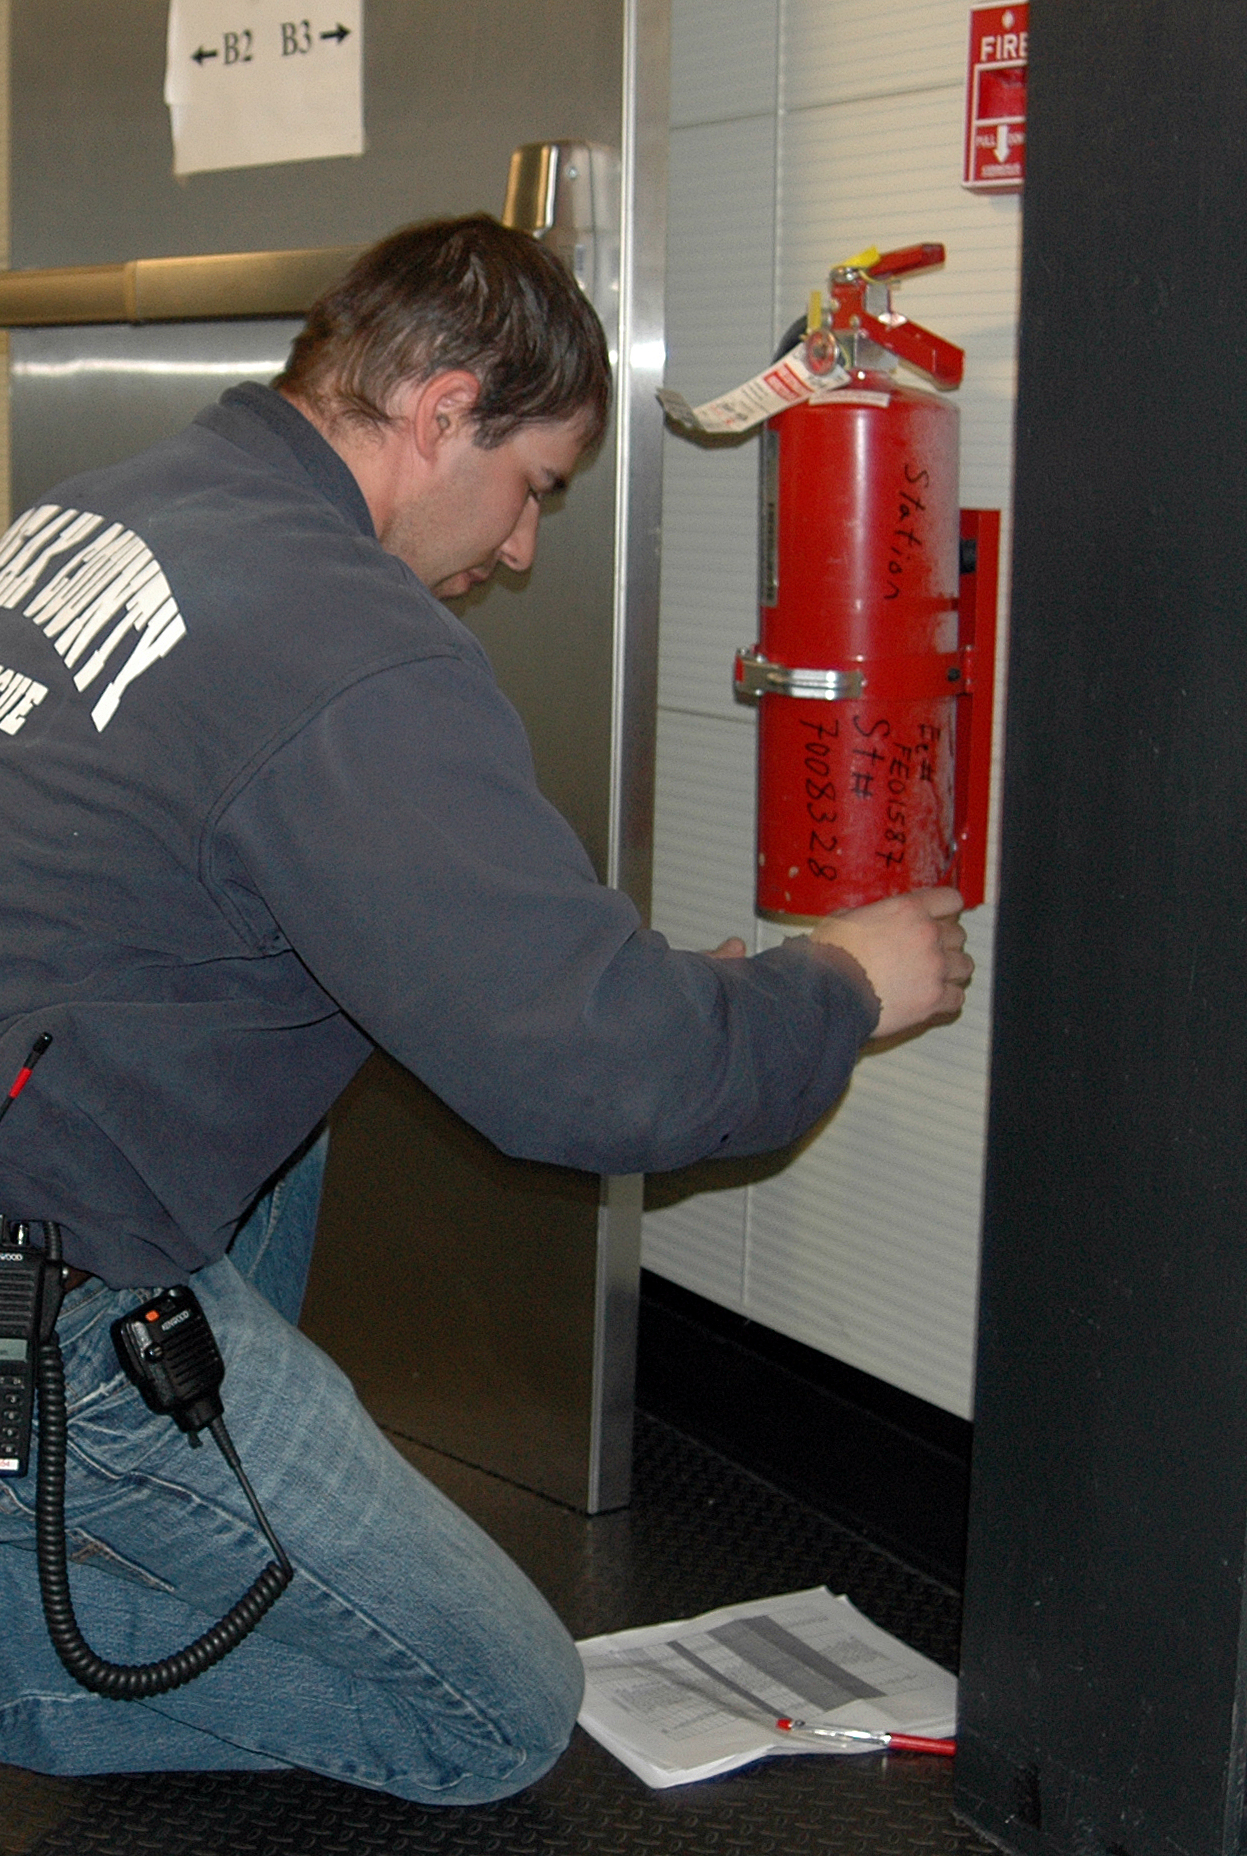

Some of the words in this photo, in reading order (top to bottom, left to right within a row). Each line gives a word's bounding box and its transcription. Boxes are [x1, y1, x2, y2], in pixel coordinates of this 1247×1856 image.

[222, 29, 253, 65] B2
[280, 19, 313, 57] B3
[884, 463, 930, 600] Station
[22, 521, 187, 733] COUNTY
[799, 719, 840, 881] 7008328
[161, 1310, 190, 1331] KENWOOD
